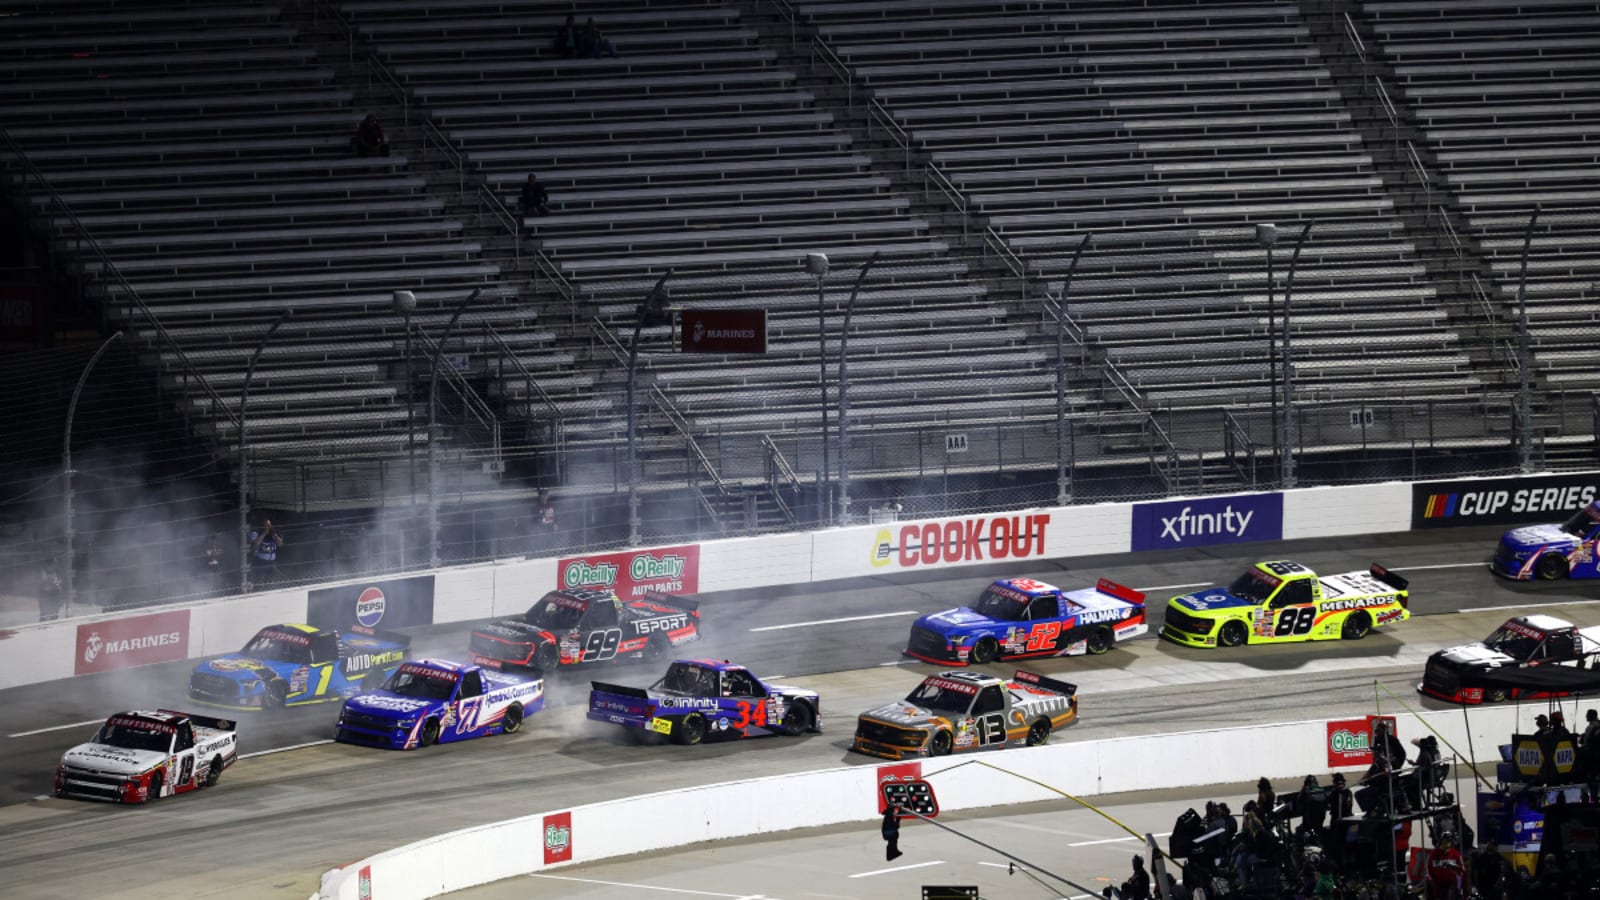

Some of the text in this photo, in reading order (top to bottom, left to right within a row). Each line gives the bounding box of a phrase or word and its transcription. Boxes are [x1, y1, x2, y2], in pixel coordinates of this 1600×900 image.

[707, 329, 755, 338] MARINES
[1459, 485, 1597, 516] CUP SERIES
[1160, 505, 1254, 541] xfinity
[898, 513, 1050, 567] COOK OUT
[564, 562, 617, 587] O'Reilly
[631, 555, 685, 580] O'Reilly
[655, 580, 683, 593] PARTS
[358, 601, 384, 613] PEPSI
[1320, 594, 1396, 612] MENARDS
[1080, 608, 1121, 625] HALMAR
[1274, 606, 1317, 637] 88
[105, 631, 180, 654] MARINES
[582, 628, 622, 662] 99
[1026, 620, 1063, 651] 52
[315, 664, 334, 696] 1
[401, 664, 455, 682] CRAFTSMAN
[925, 676, 972, 694] CRAFTSMAN
[111, 717, 170, 733] CRAFTSMAN
[456, 695, 484, 734] 71
[733, 698, 767, 728] 34
[975, 713, 1007, 747] 13
[1331, 731, 1370, 752] O'Reill
[177, 753, 195, 786] 19
[1519, 749, 1540, 765] NAPA
